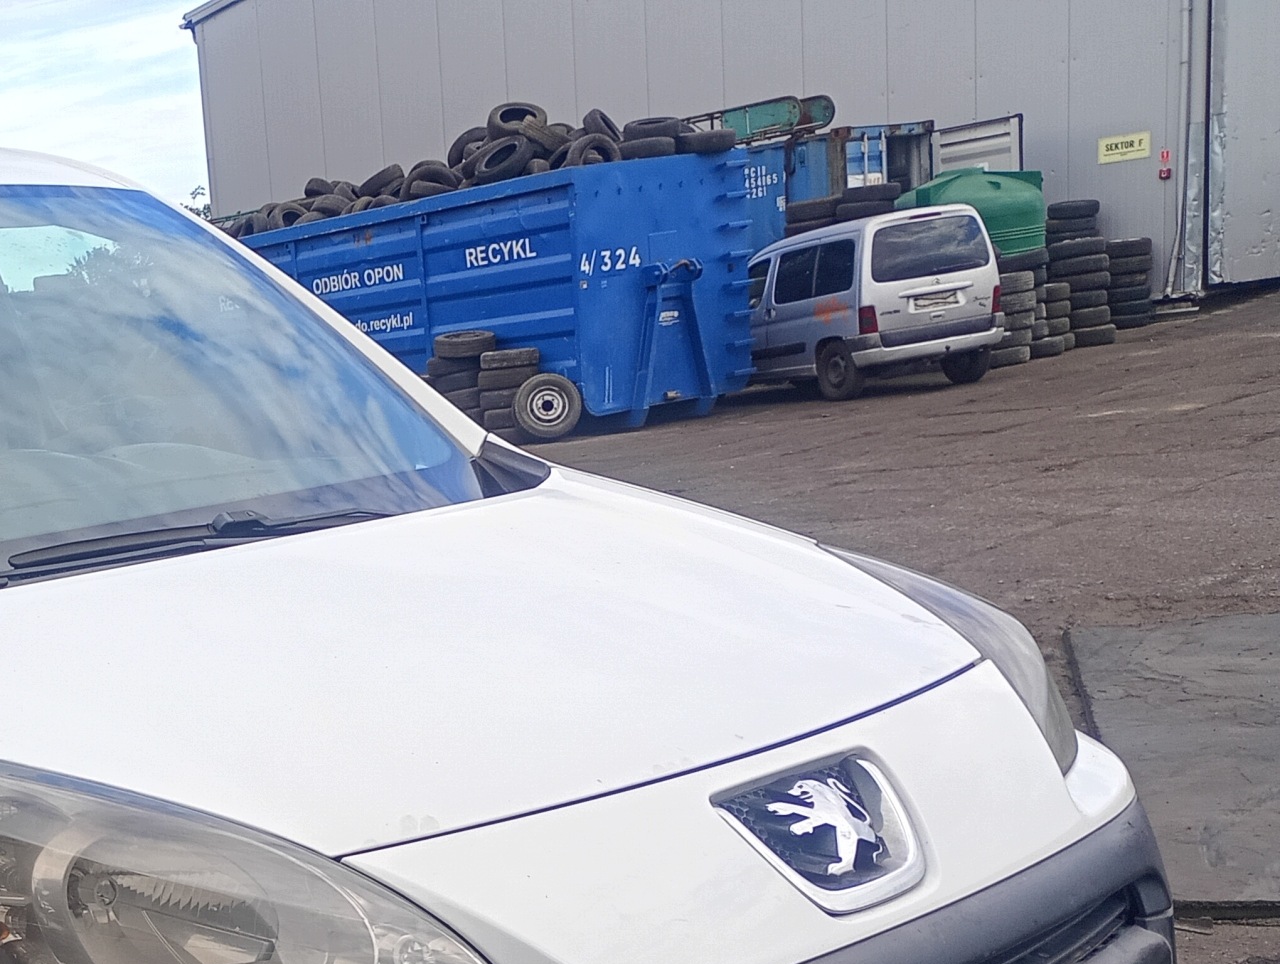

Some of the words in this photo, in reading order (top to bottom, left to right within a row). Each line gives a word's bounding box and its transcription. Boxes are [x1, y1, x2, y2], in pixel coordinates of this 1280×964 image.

[1104, 139, 1135, 152] SEKTOR
[1138, 138, 1144, 148] F
[465, 238, 537, 269] RECYKL
[312, 268, 361, 295] ODBIÓR
[363, 263, 404, 286] OPON
